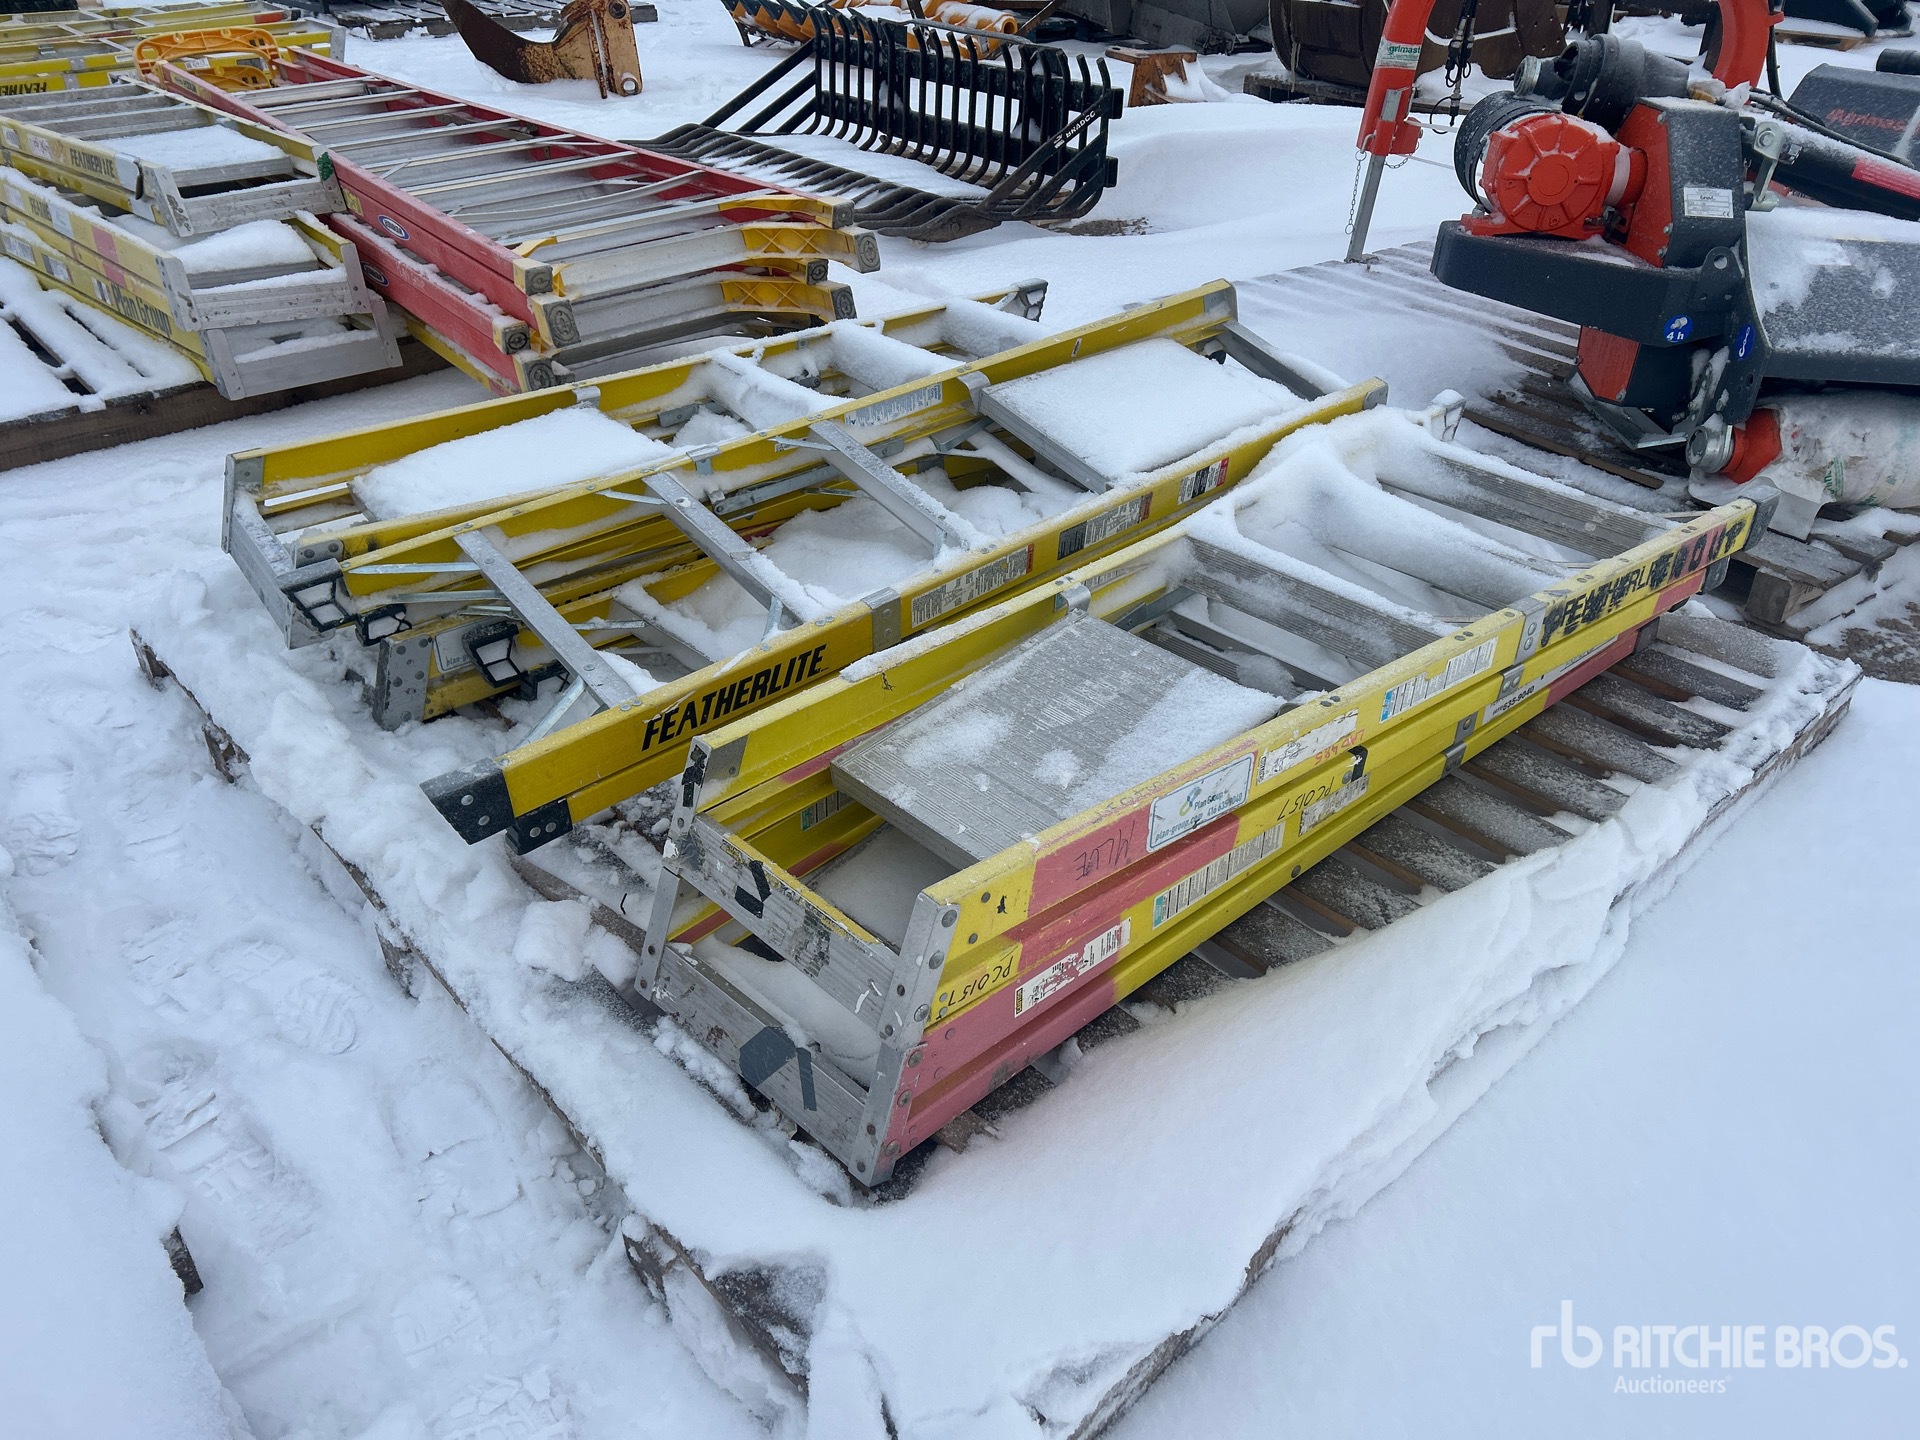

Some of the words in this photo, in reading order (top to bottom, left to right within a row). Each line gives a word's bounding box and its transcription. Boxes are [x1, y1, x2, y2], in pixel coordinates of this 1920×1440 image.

[1388, 45, 1421, 54] grimast
[1826, 108, 1907, 132] Agrimas
[111, 282, 139, 323] Plan
[136, 296, 172, 337] Group
[1666, 331, 1674, 340] 4
[1677, 331, 1685, 340] h
[642, 644, 827, 751] FEATHERLITE
[1341, 728, 1365, 748] LAD
[1194, 797, 1208, 811] Plan
